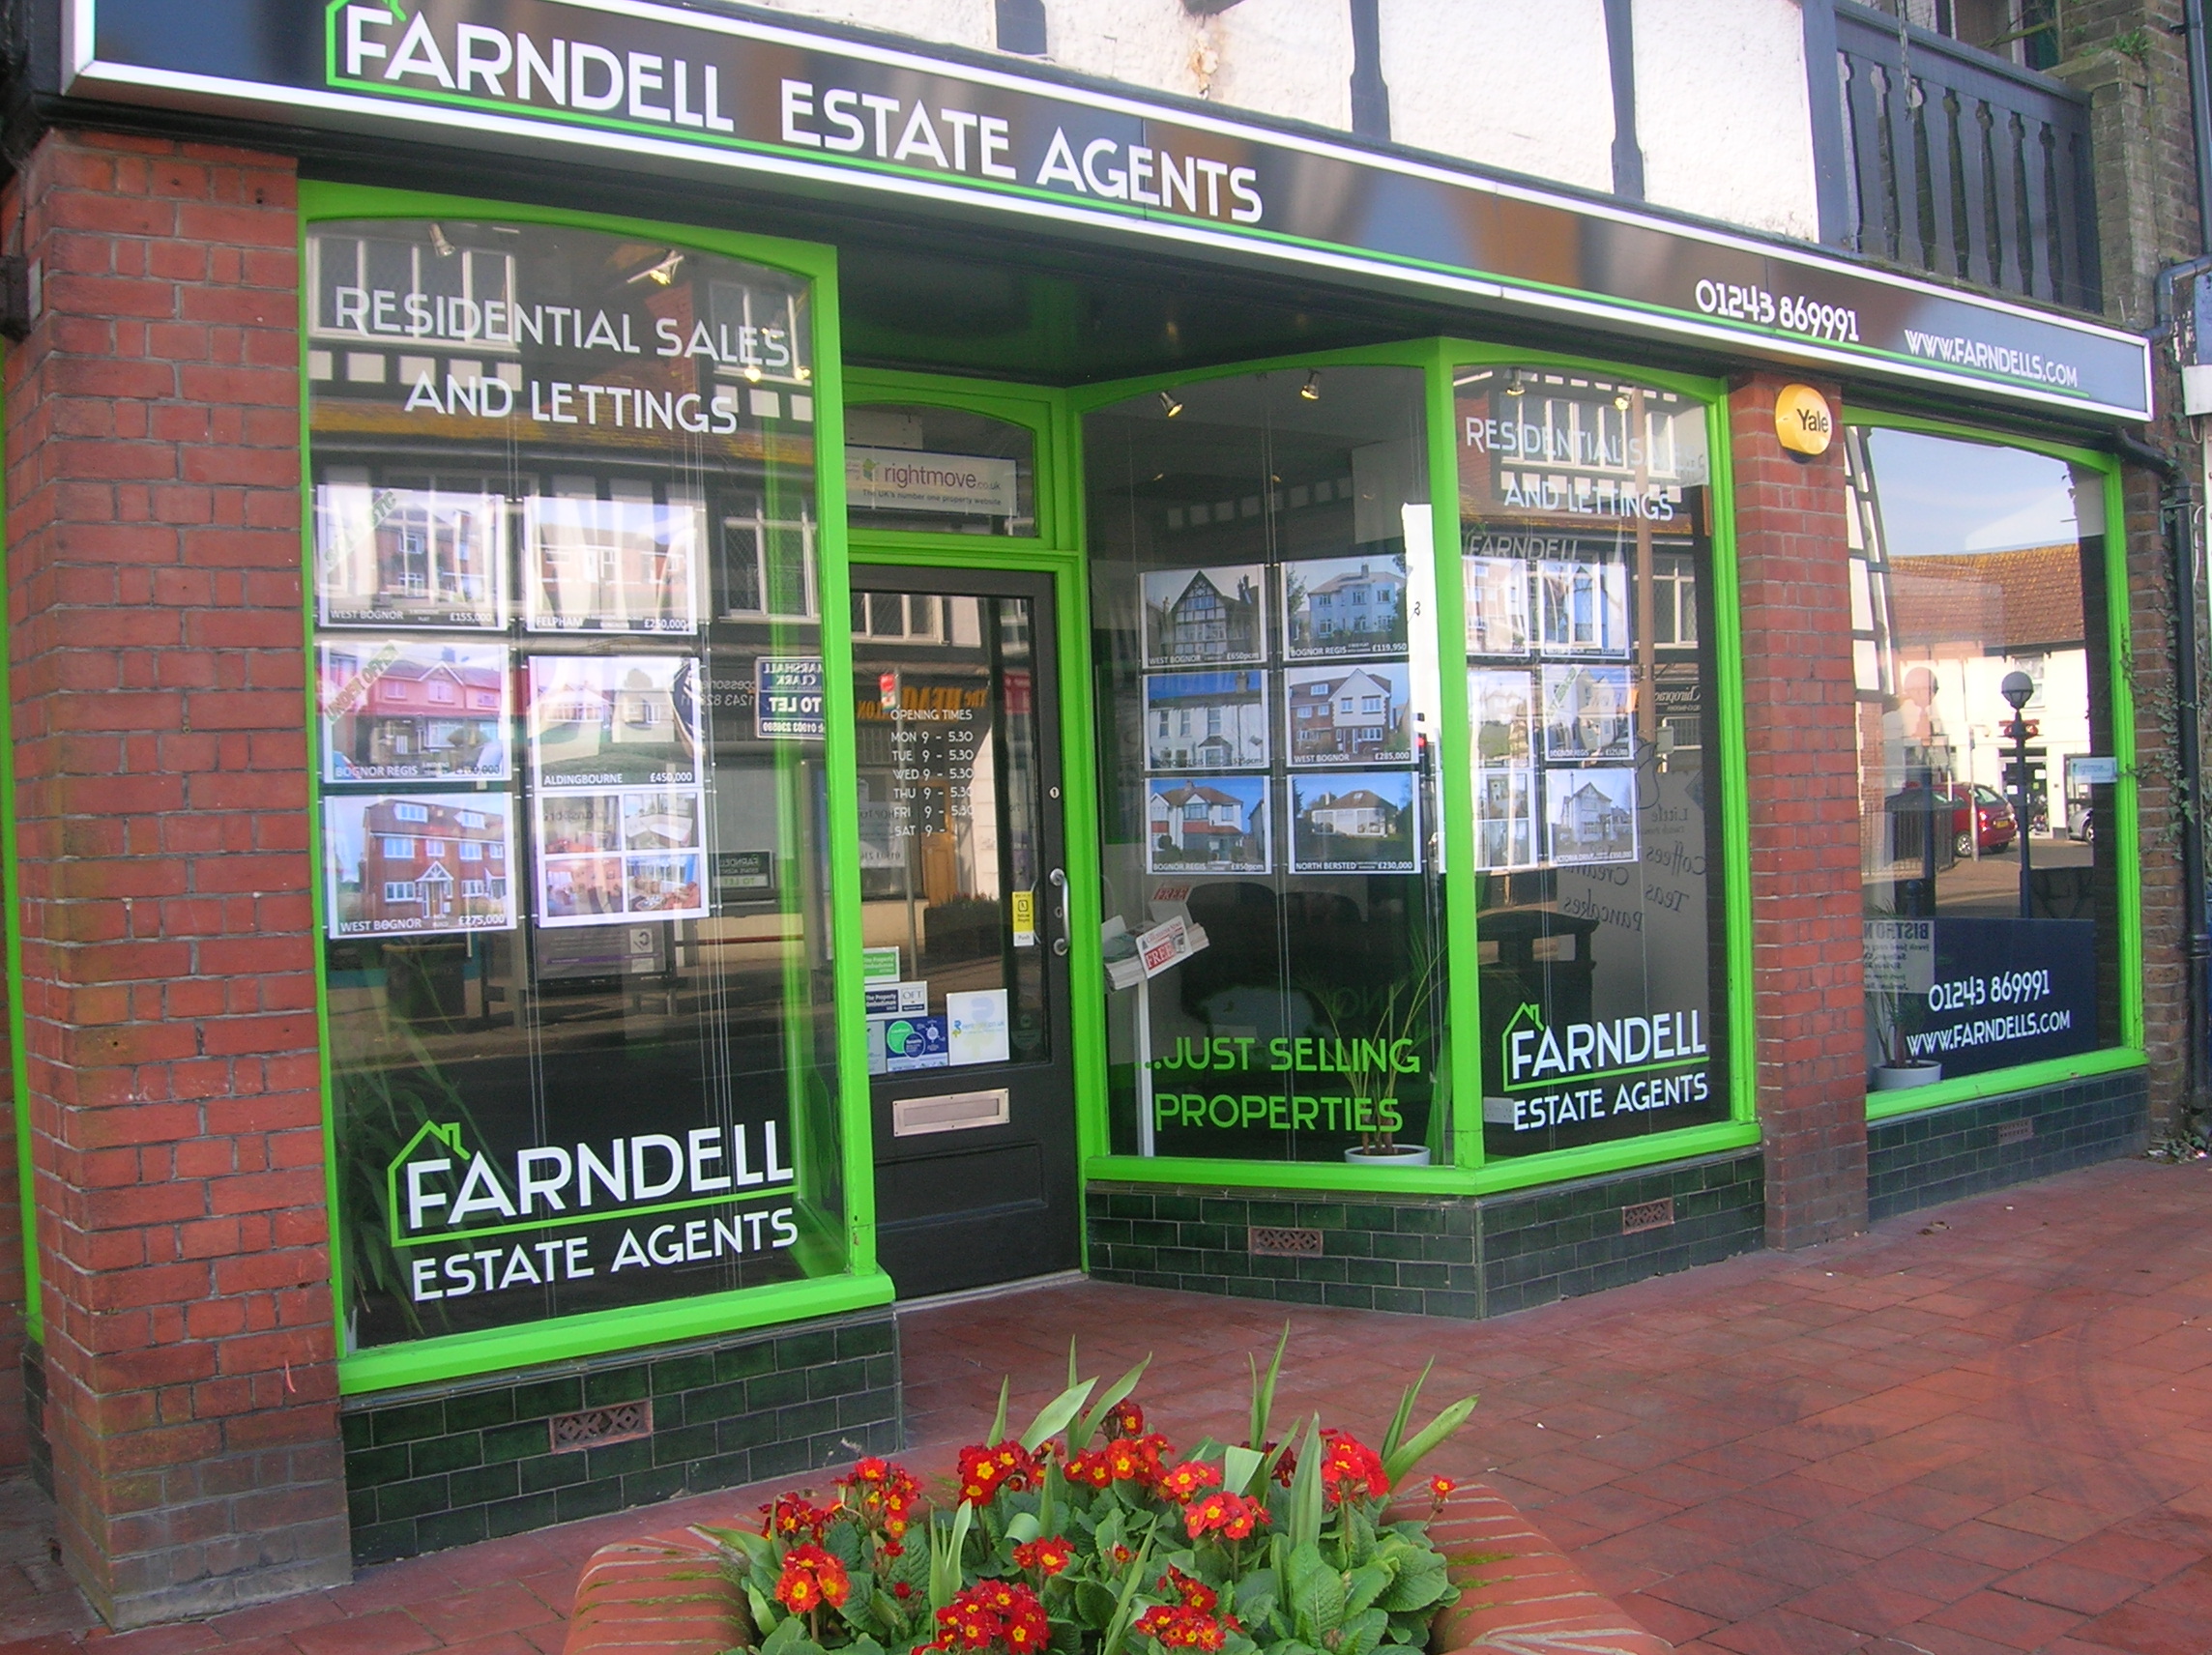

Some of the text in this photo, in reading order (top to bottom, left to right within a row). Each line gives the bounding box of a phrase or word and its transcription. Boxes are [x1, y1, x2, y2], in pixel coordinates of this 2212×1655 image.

[346, 5, 1263, 222] FARNDELL ESTATE AGENTS
[1696, 279, 1860, 342] 01243 869991
[335, 286, 790, 366] RESIDENTIAL SALES
[1905, 330, 2078, 388] WWW.FARNDELLS.COM
[405, 370, 737, 434] AND LETTINGS
[1796, 408, 1829, 434] Yale
[1466, 417, 1622, 464] RESIDENTIAL
[897, 492, 924, 501] number
[942, 496, 973, 505] property
[1504, 477, 1674, 522] AND LETTINGS
[1470, 536, 1581, 563] FARNDELL
[330, 610, 358, 621] WEST
[360, 610, 405, 621] BOGNOR
[450, 612, 493, 624] £155,000
[536, 616, 585, 627] FELPHAM
[1291, 648, 1324, 657] BOGNOR
[1325, 645, 1348, 654] REGIS
[1372, 643, 1407, 653] £119,950
[1170, 654, 1201, 664] BOGNOR
[890, 708, 973, 721] OPENING TIMES
[890, 731, 917, 743] MON
[921, 731, 929, 744] 9
[947, 731, 974, 743] 5.30
[891, 750, 914, 762] TUE
[921, 750, 930, 764] 9
[948, 749, 975, 763] 5.30
[1294, 751, 1410, 764] WEST BOGNOR £285,000
[335, 766, 385, 777] BOGNOR
[387, 765, 419, 776] REGIS
[543, 771, 693, 785] ALDINGBOURNE £450,000
[892, 769, 919, 780] WED
[922, 769, 931, 783] 9
[949, 769, 975, 780] 5.30
[893, 787, 917, 799] THU
[923, 787, 932, 801] 9
[950, 787, 975, 799] 5.30
[894, 806, 912, 819] FRI
[923, 806, 933, 821] 9
[950, 805, 975, 818] 5.30
[894, 825, 917, 837] SAT
[924, 825, 934, 839] 9
[1295, 860, 1413, 870] NORTH BERSTED £230,000
[339, 918, 422, 932] WEST BOGNOR
[458, 914, 506, 926] £275,000
[1146, 942, 1176, 971] FREE
[1928, 977, 1985, 1012] 01243
[1990, 969, 2051, 1005] 869991
[1906, 1009, 2071, 1057] WWW.FARNDELLS.COM
[1511, 1009, 1706, 1080] FARNDELL
[1269, 1037, 1420, 1073] SELLING
[1513, 1072, 1708, 1132] ESTATE AGENTS
[1155, 1093, 1403, 1132] PROPERTIES
[406, 1120, 794, 1230] FARNDELL
[413, 1207, 799, 1302] ESTATE AGENTS
